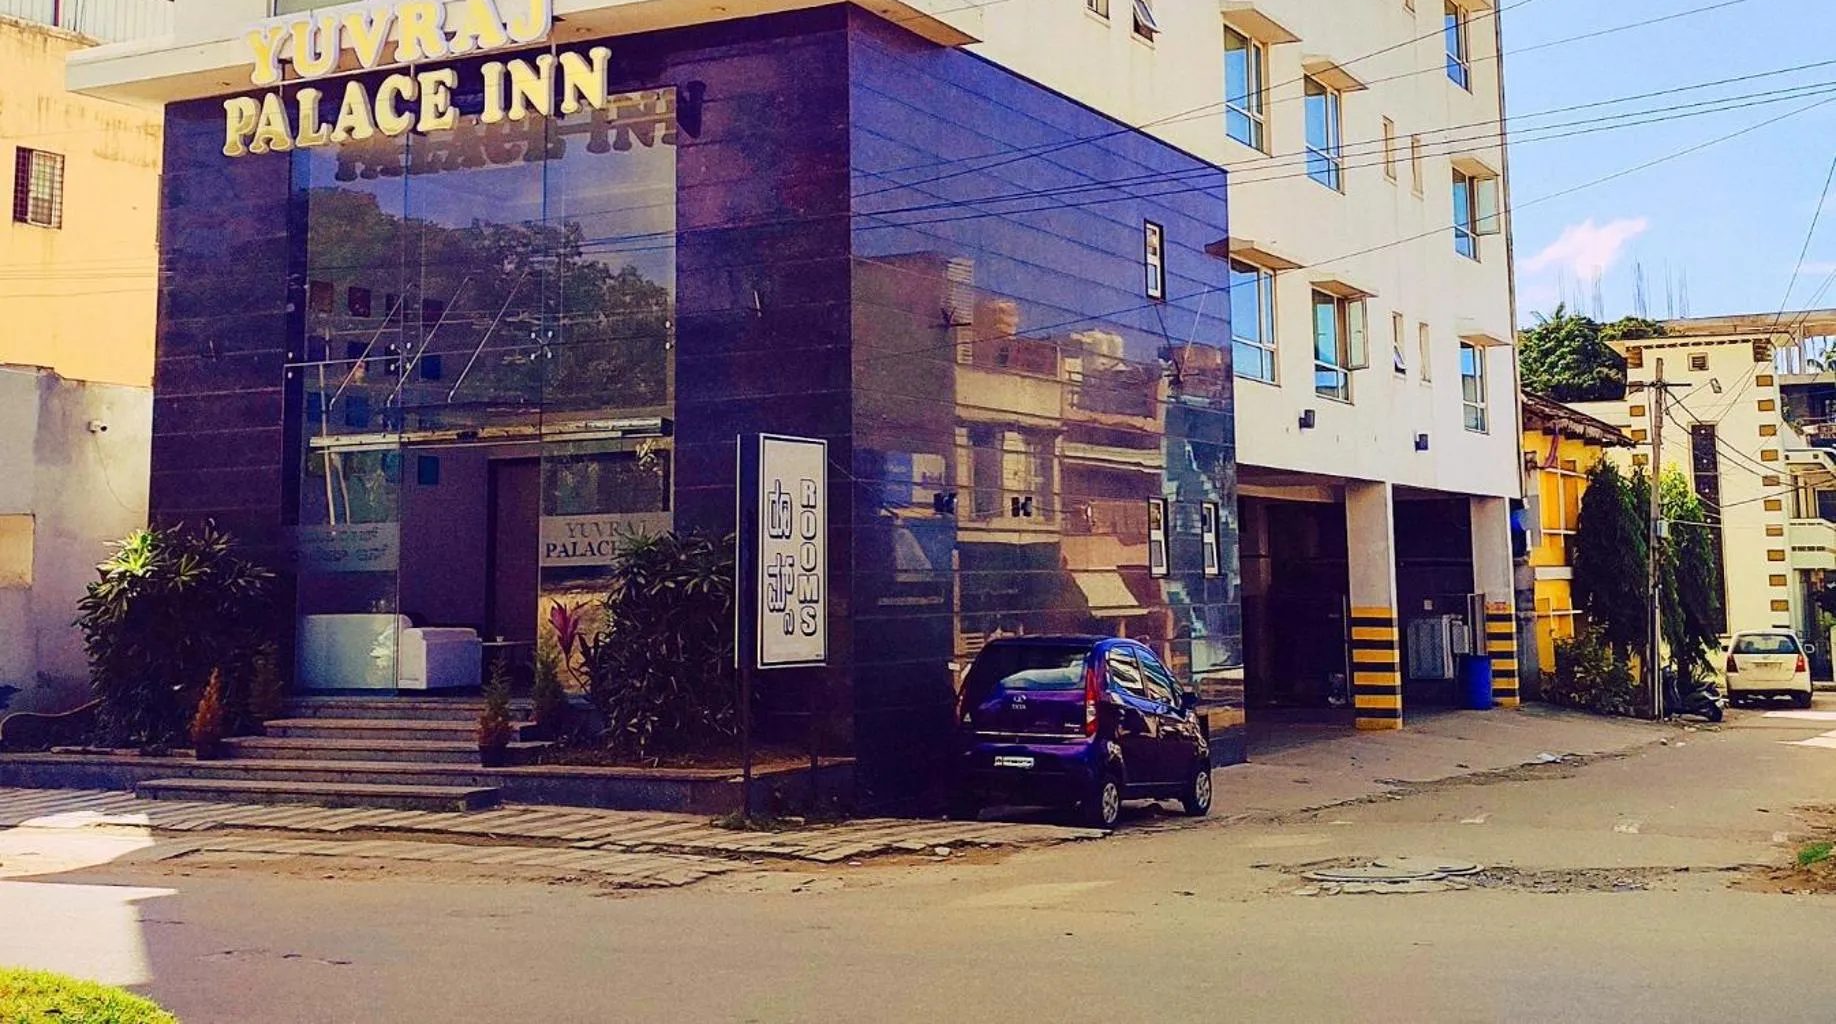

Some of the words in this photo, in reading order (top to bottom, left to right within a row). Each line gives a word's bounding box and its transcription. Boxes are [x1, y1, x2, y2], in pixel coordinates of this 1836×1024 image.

[222, 68, 460, 157] PALACE
[479, 46, 612, 126] INN
[797, 478, 820, 637] ROOMS
